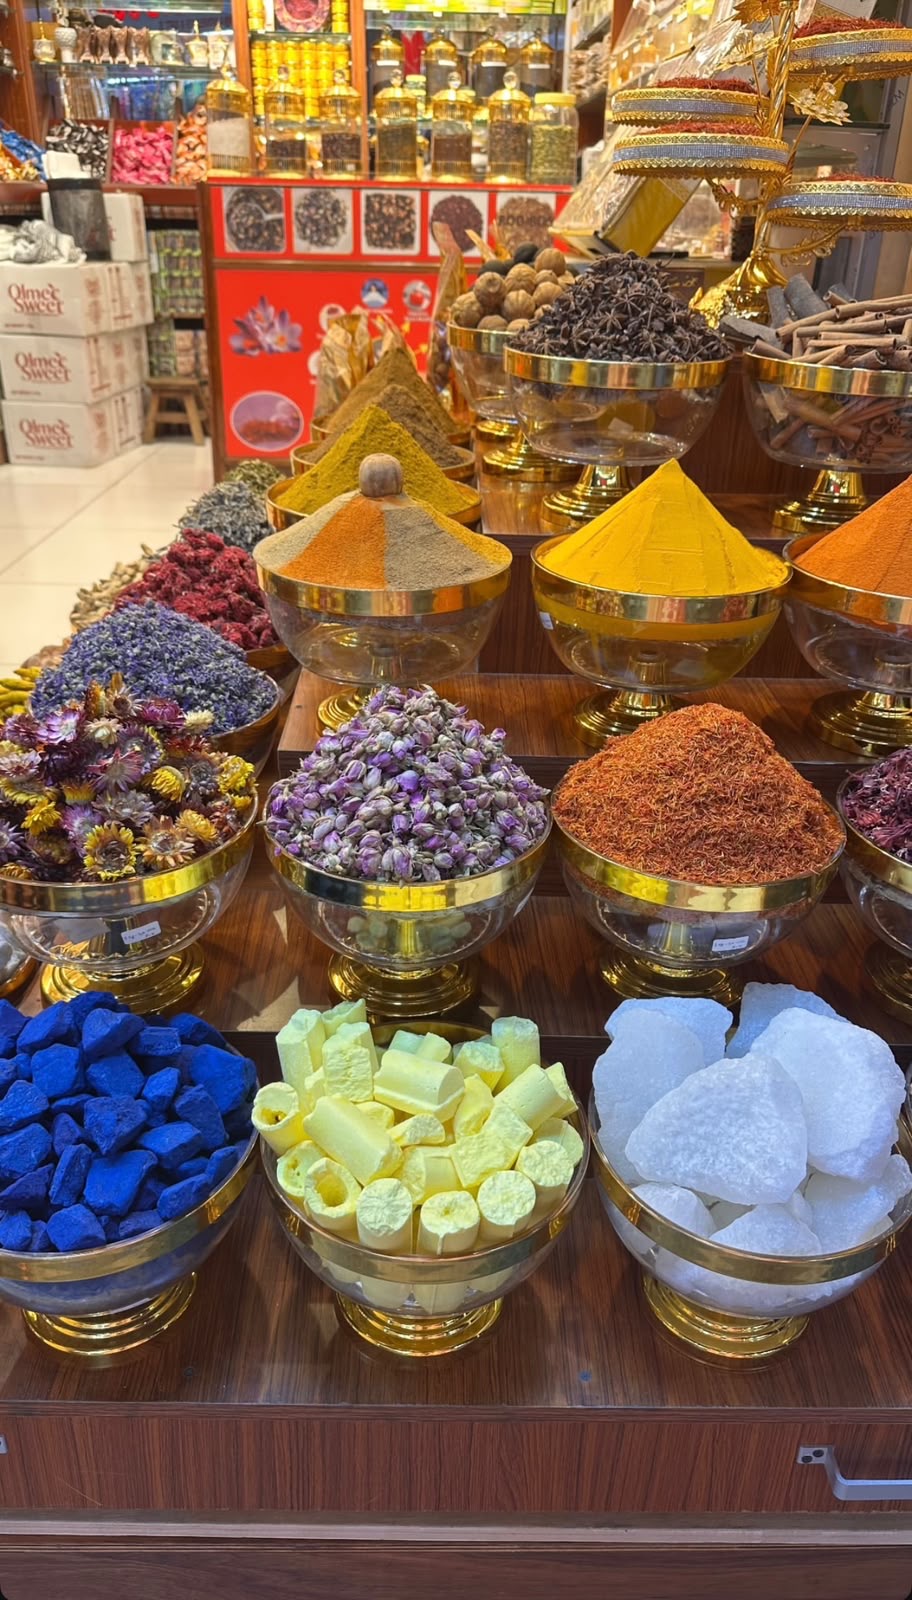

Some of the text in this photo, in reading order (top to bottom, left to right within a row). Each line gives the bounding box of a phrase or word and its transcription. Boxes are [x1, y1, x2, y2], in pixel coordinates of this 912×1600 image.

[14, 299, 64, 315] Sweet
[20, 366, 72, 382] Sweet
[25, 433, 74, 448] Sweet
